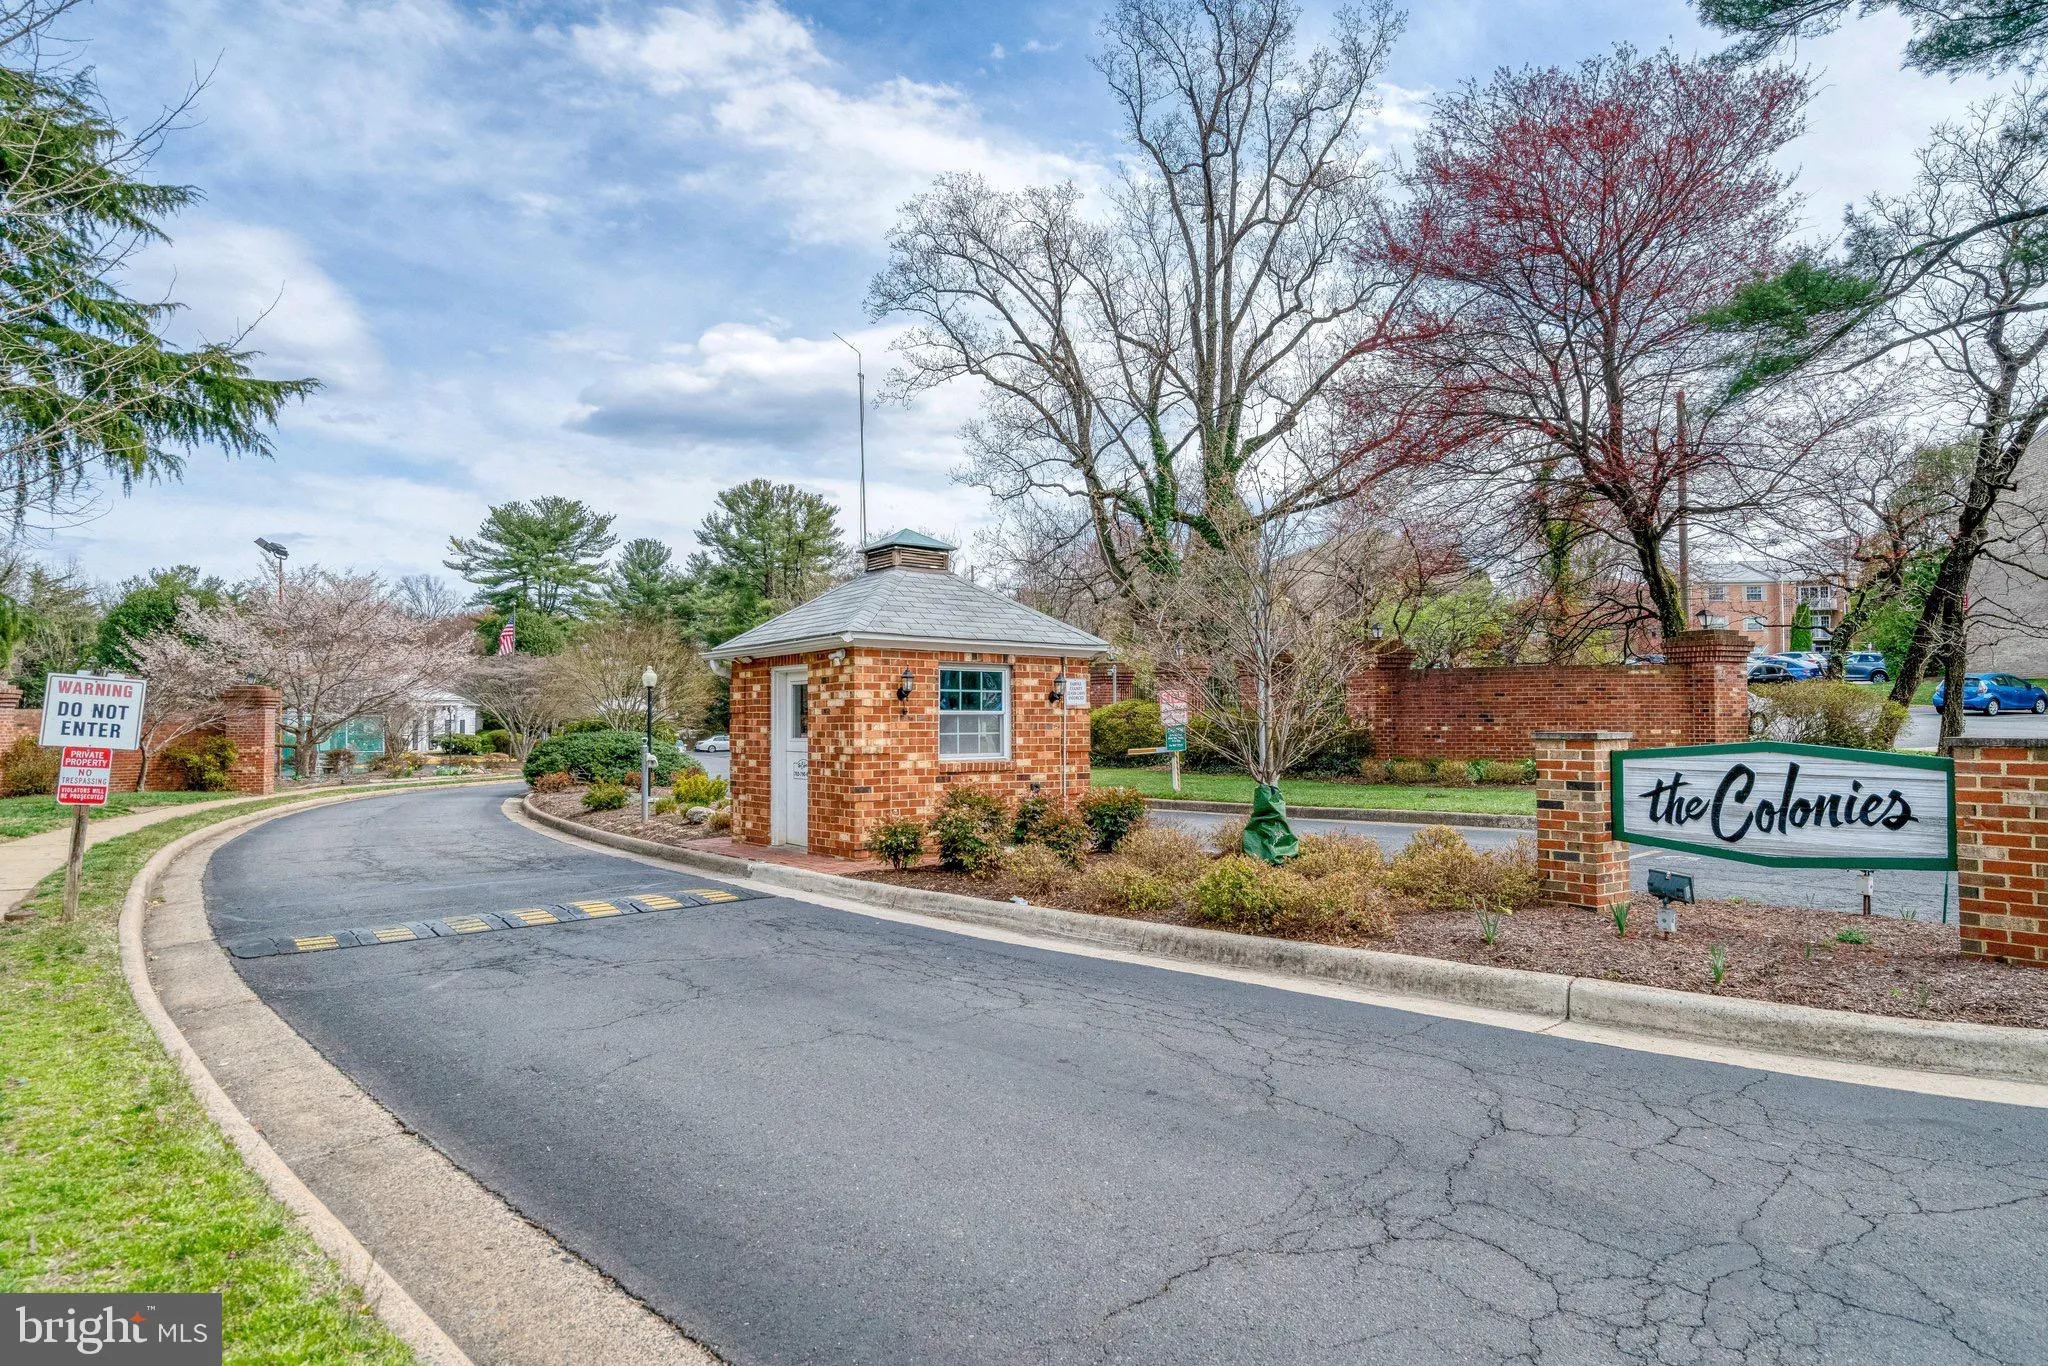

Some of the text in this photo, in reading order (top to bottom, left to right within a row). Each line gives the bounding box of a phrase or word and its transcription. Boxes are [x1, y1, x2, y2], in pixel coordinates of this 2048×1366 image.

[58, 680, 133, 698] WARNING
[58, 701, 129, 720] DO NOT
[60, 720, 121, 738] ENTER
[64, 758, 108, 767] PROPERTY
[70, 750, 104, 760] PRIVATE
[62, 776, 107, 785] TRESPASSING
[1639, 761, 1920, 842] the Colonies
